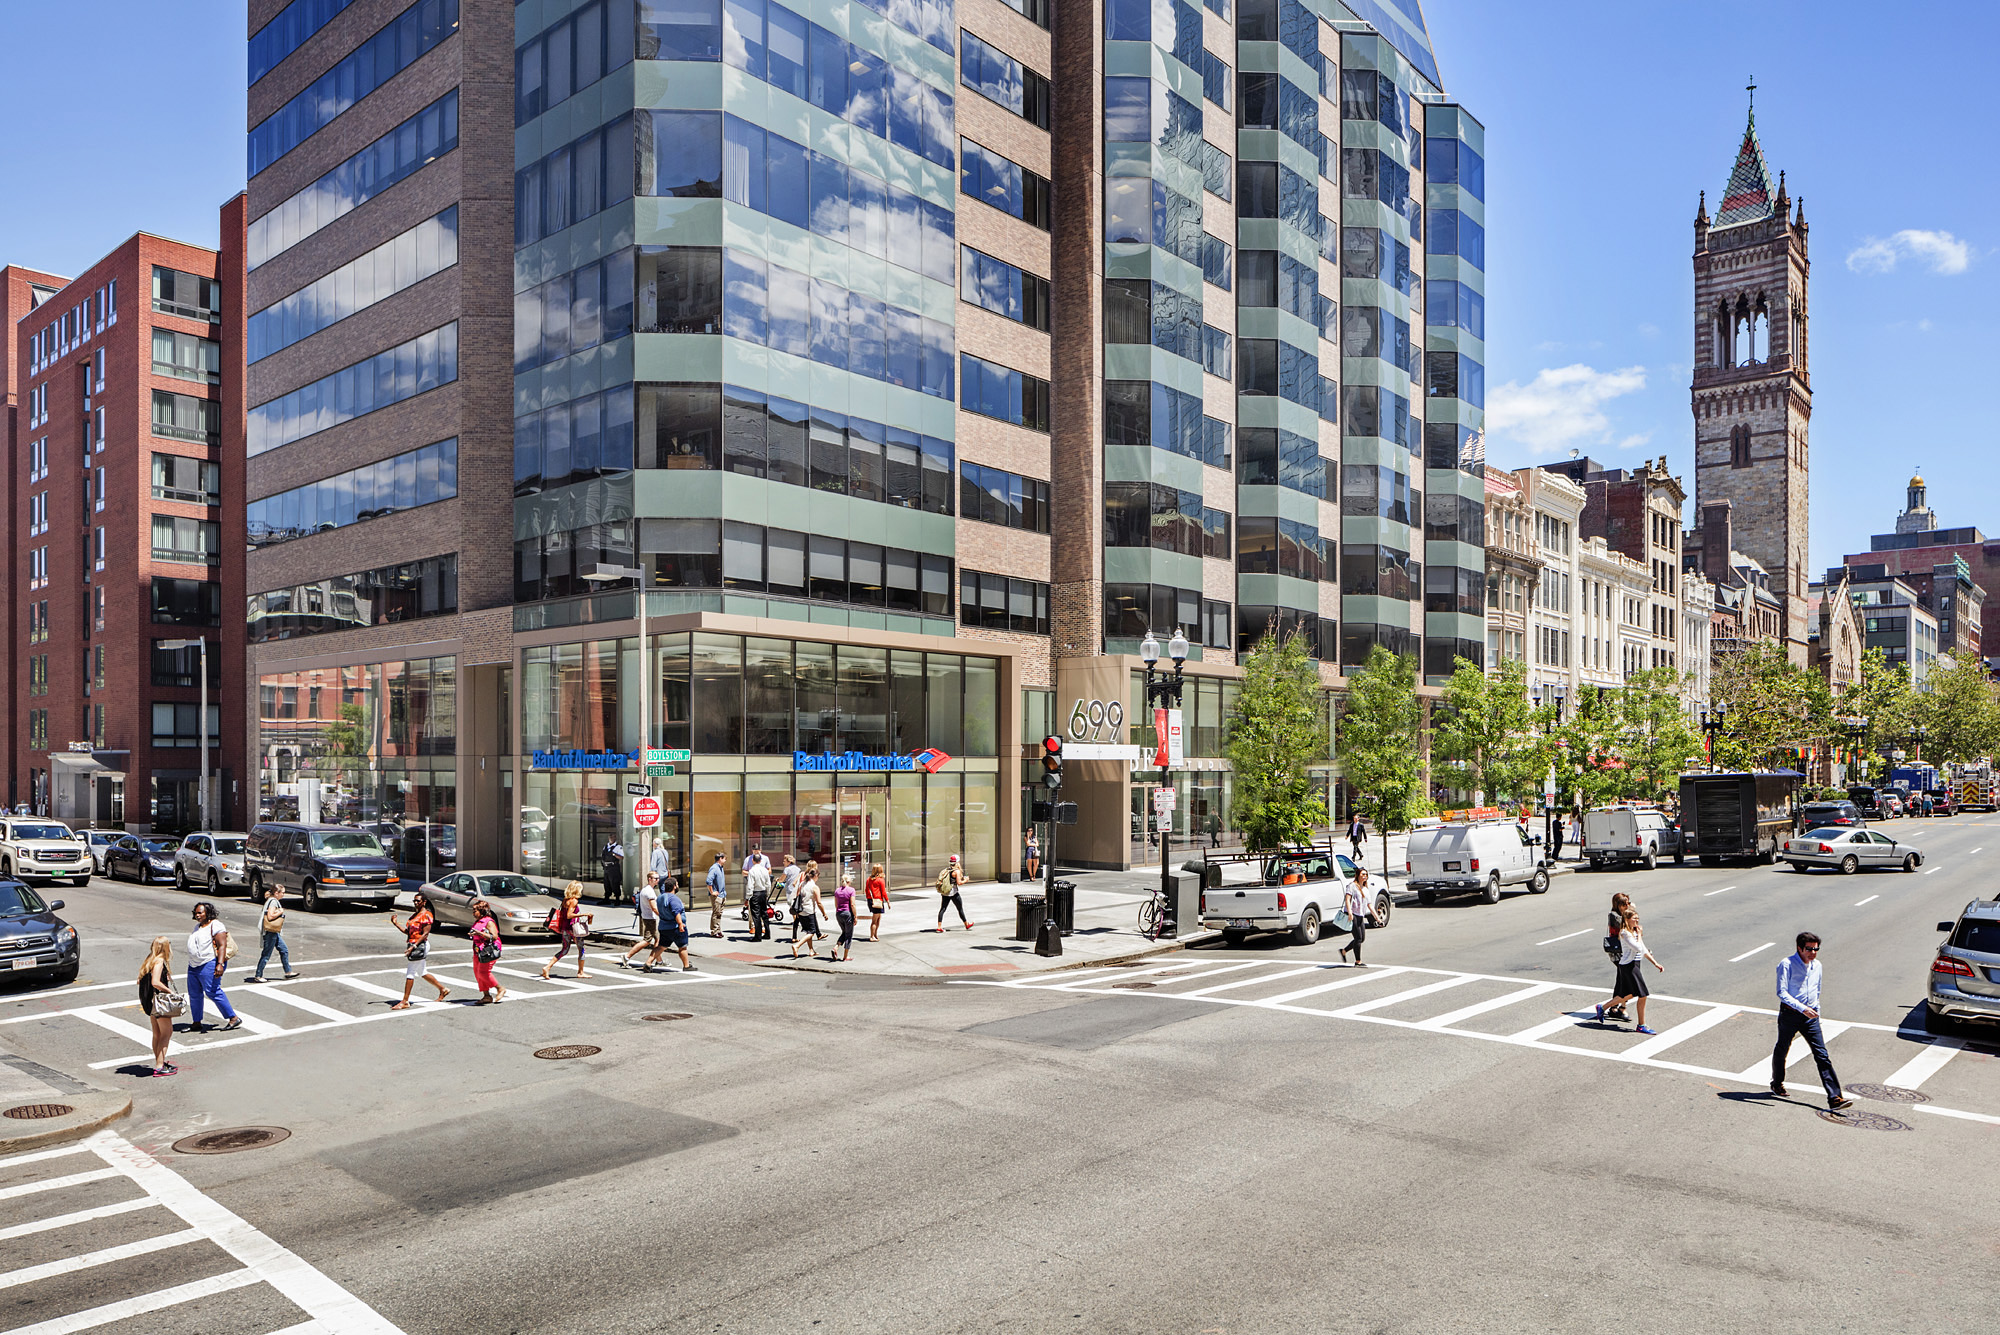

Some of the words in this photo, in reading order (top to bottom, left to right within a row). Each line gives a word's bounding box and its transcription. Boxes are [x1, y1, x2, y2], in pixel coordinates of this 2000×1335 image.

[1068, 699, 1124, 742] 699
[648, 751, 683, 760] BOYLSTON
[649, 767, 667, 776] EXETER
